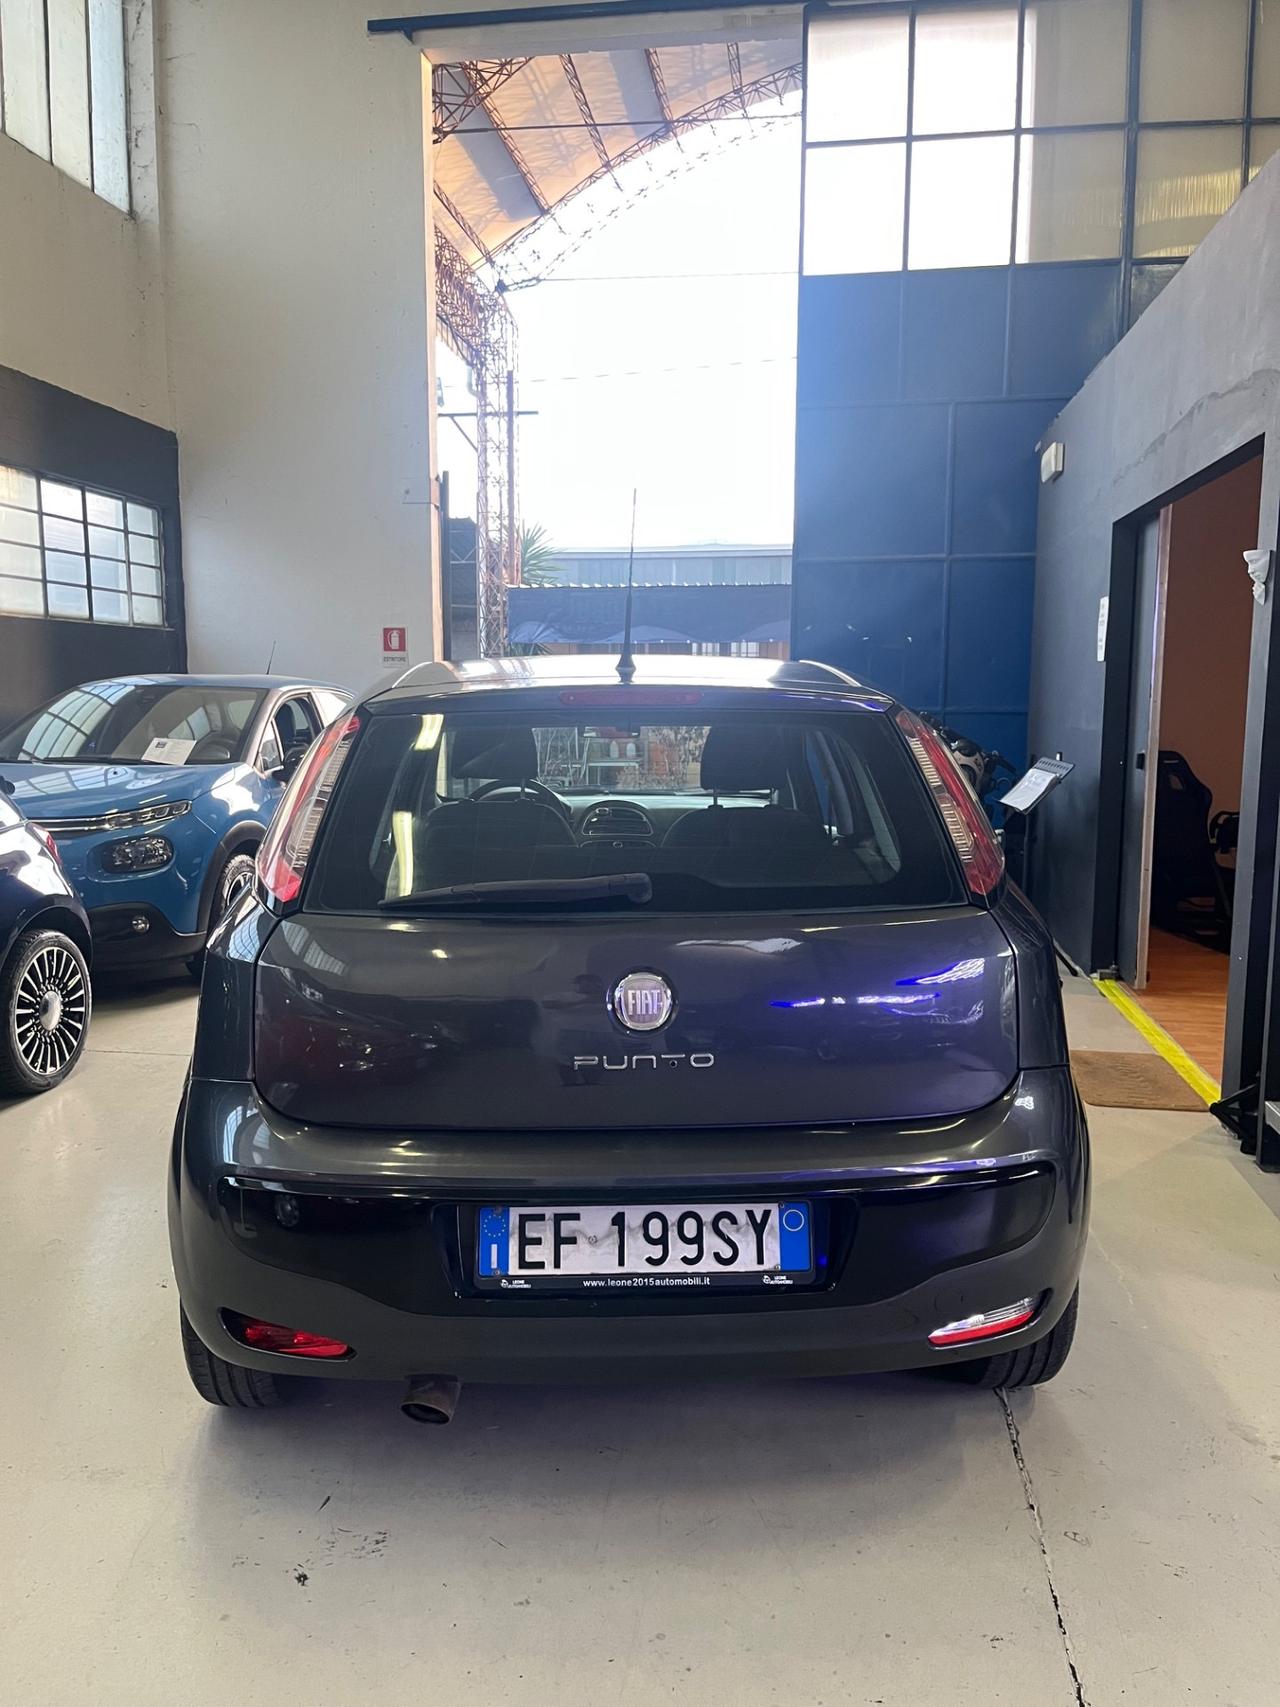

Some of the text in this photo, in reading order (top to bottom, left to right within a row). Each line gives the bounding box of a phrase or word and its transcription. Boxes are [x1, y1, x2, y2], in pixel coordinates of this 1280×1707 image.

[628, 989, 661, 1015] FIAT
[574, 1053, 714, 1070] PUNTO
[582, 1276, 711, 1287] www.leone2015automobili.it
